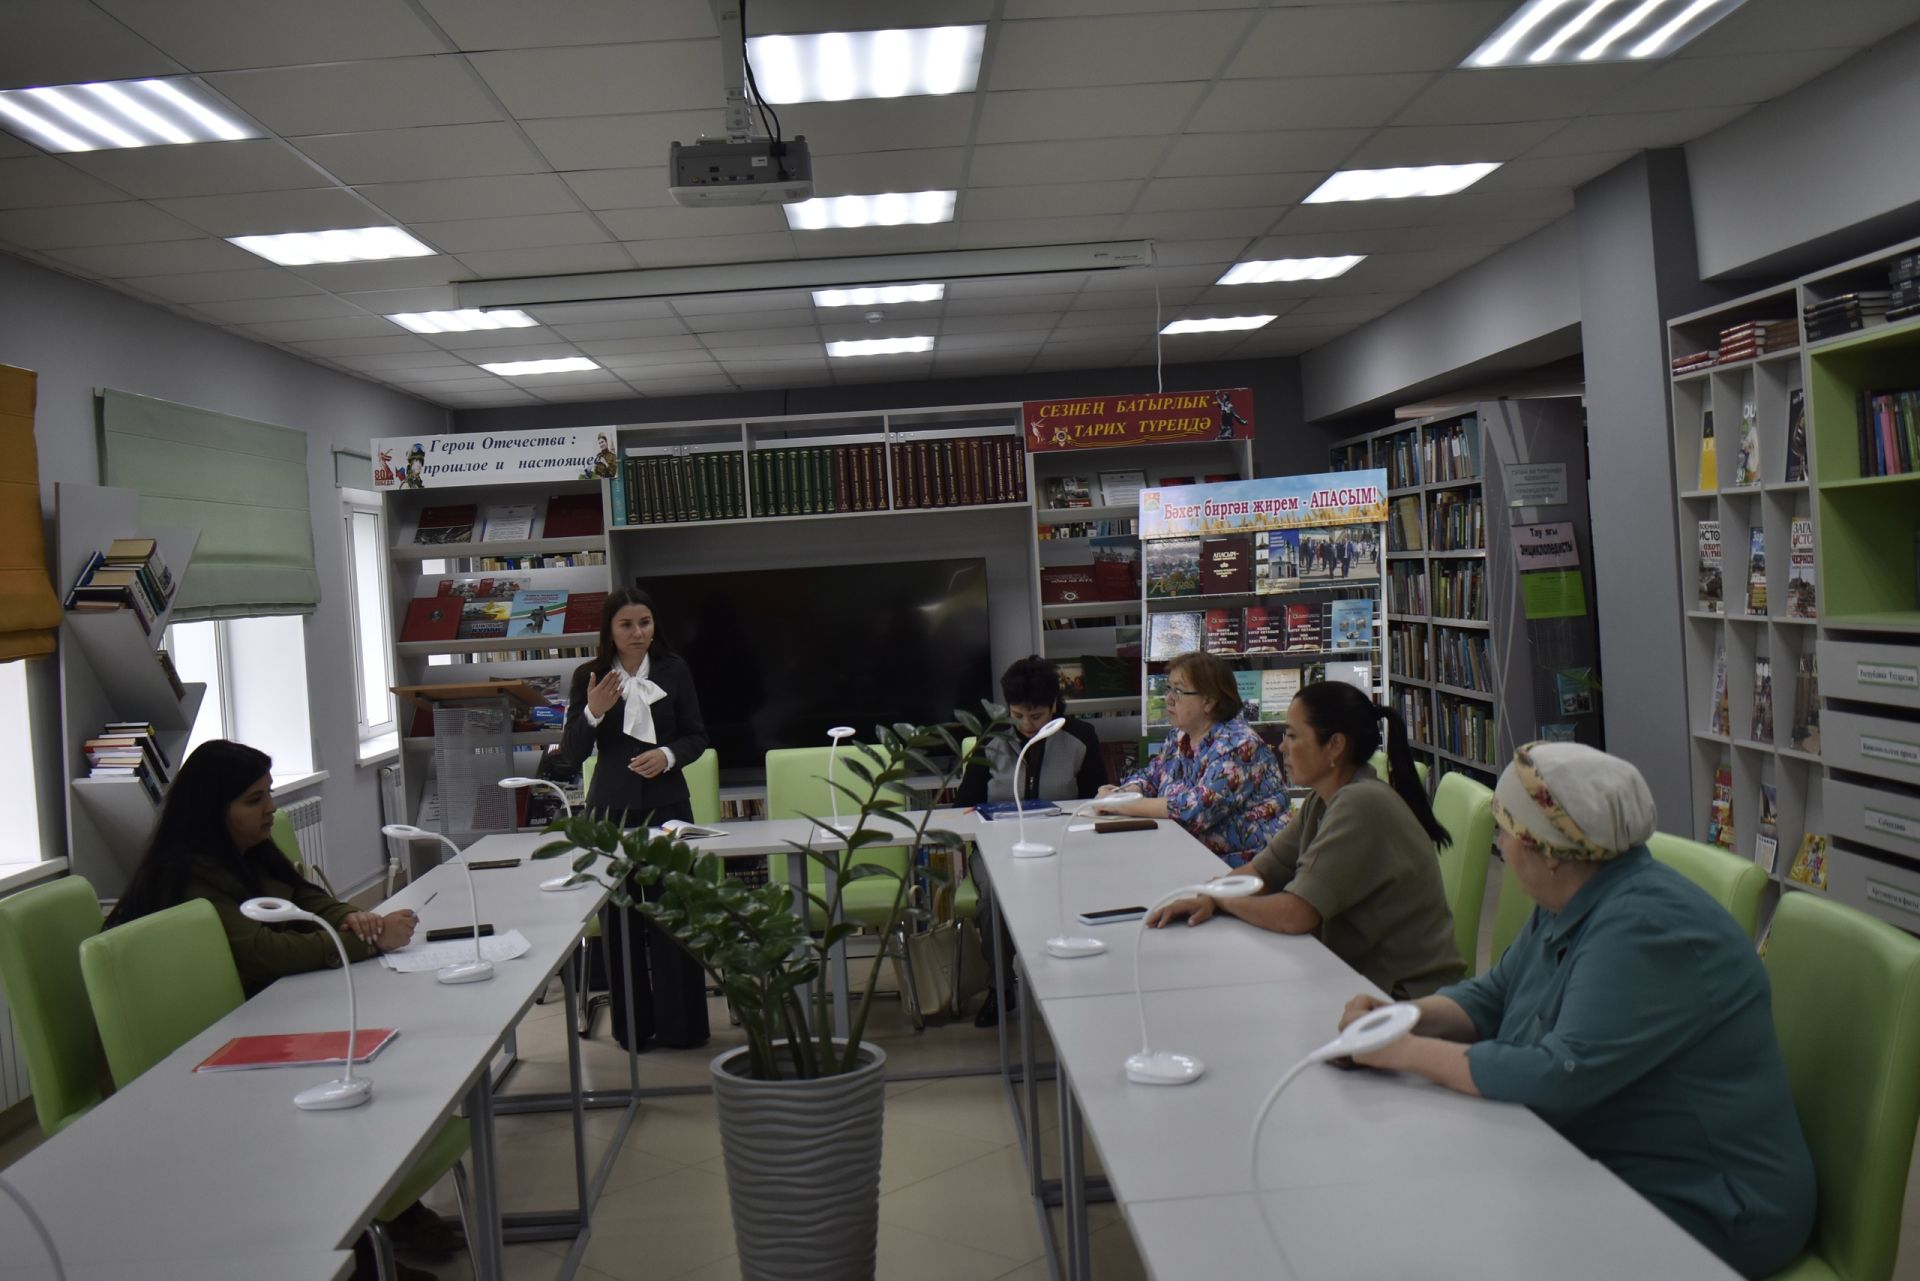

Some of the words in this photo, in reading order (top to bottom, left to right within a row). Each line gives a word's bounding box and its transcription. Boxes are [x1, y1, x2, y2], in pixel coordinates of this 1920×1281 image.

[1039, 401, 1105, 418] СЕЗНЕҢ
[1115, 395, 1211, 413] БАТЫРЛЫК
[1074, 422, 1127, 438] ТАРИХ
[1138, 416, 1213, 434] ТҮРЕНДӘ
[430, 439, 475, 455] Герои
[482, 434, 566, 452] Отечества
[423, 461, 488, 477] прошлое
[495, 461, 505, 470] и
[1164, 503, 1201, 520] Бәхет
[1204, 498, 1249, 520] биргән
[1253, 498, 1299, 516] җирем
[1310, 487, 1377, 509] АПАСЫМ!
